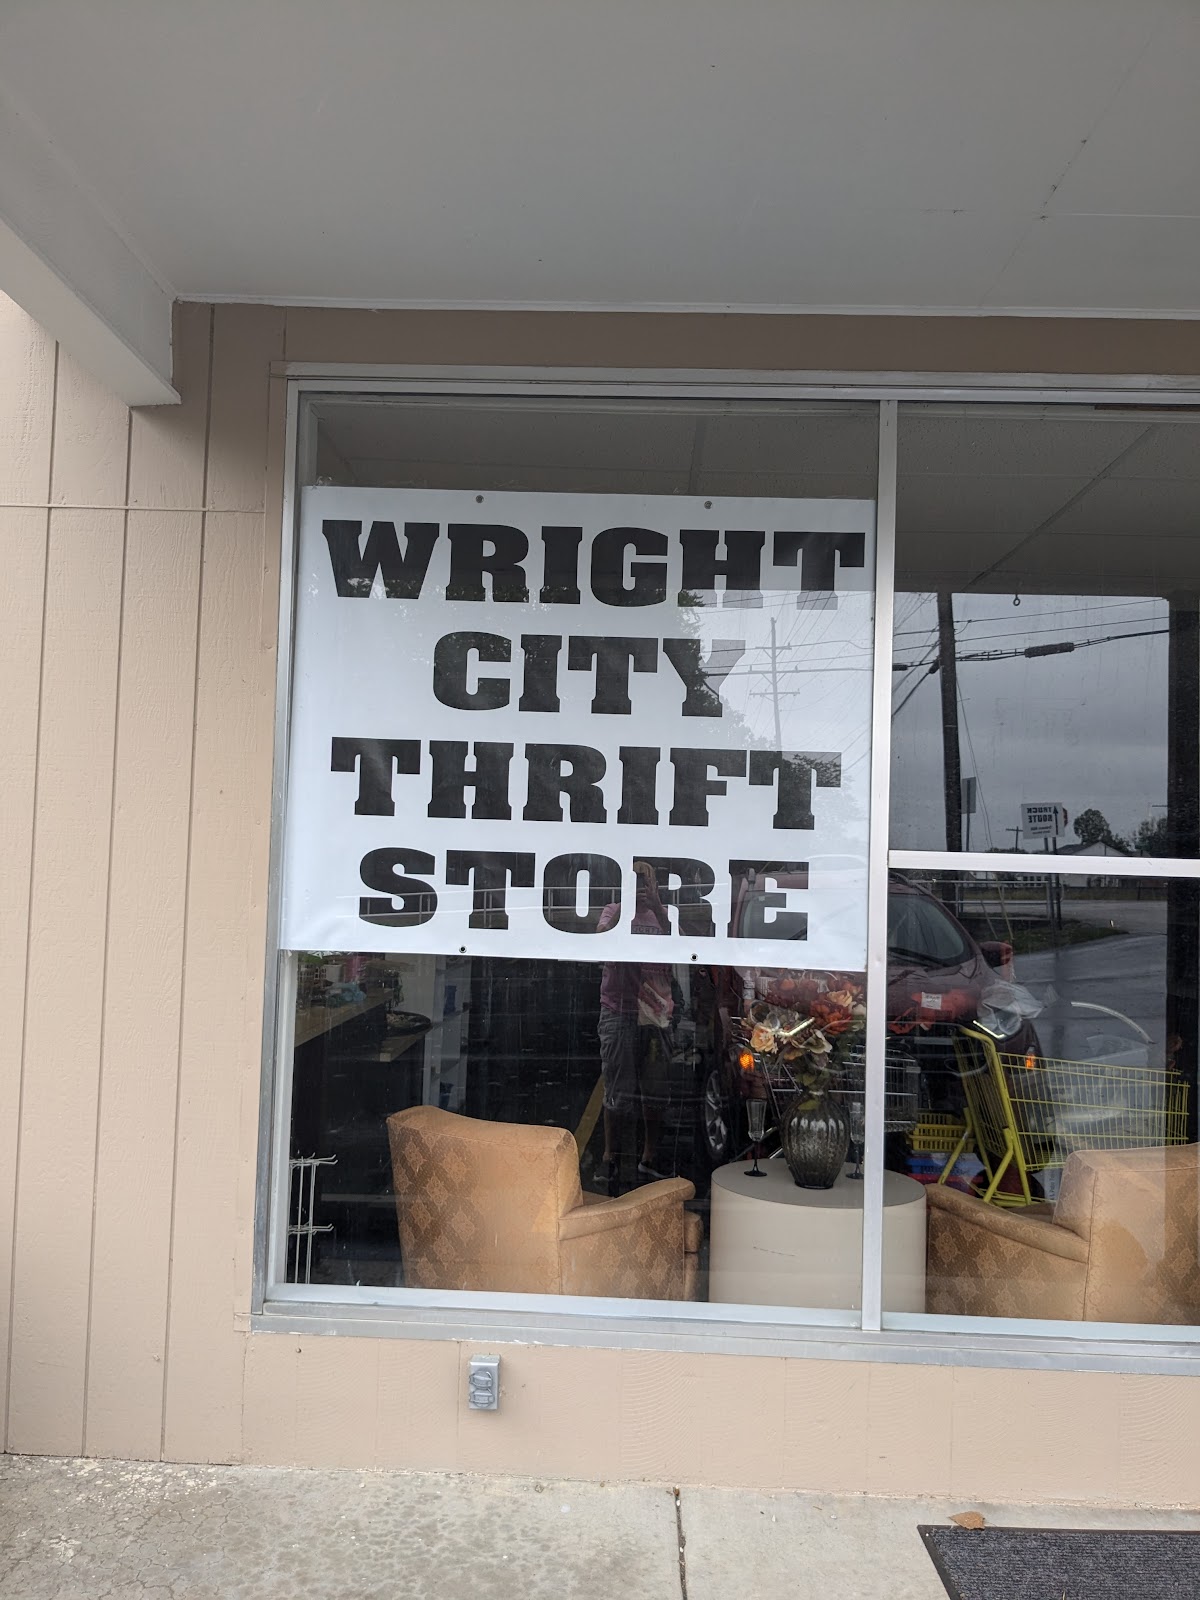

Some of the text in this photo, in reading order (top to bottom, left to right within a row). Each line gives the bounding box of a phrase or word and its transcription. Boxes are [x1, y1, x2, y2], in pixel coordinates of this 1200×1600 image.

[322, 519, 866, 611] WRIGHT
[432, 630, 746, 718] CITY
[330, 736, 842, 830] THRIFT
[358, 846, 810, 941] STORE
